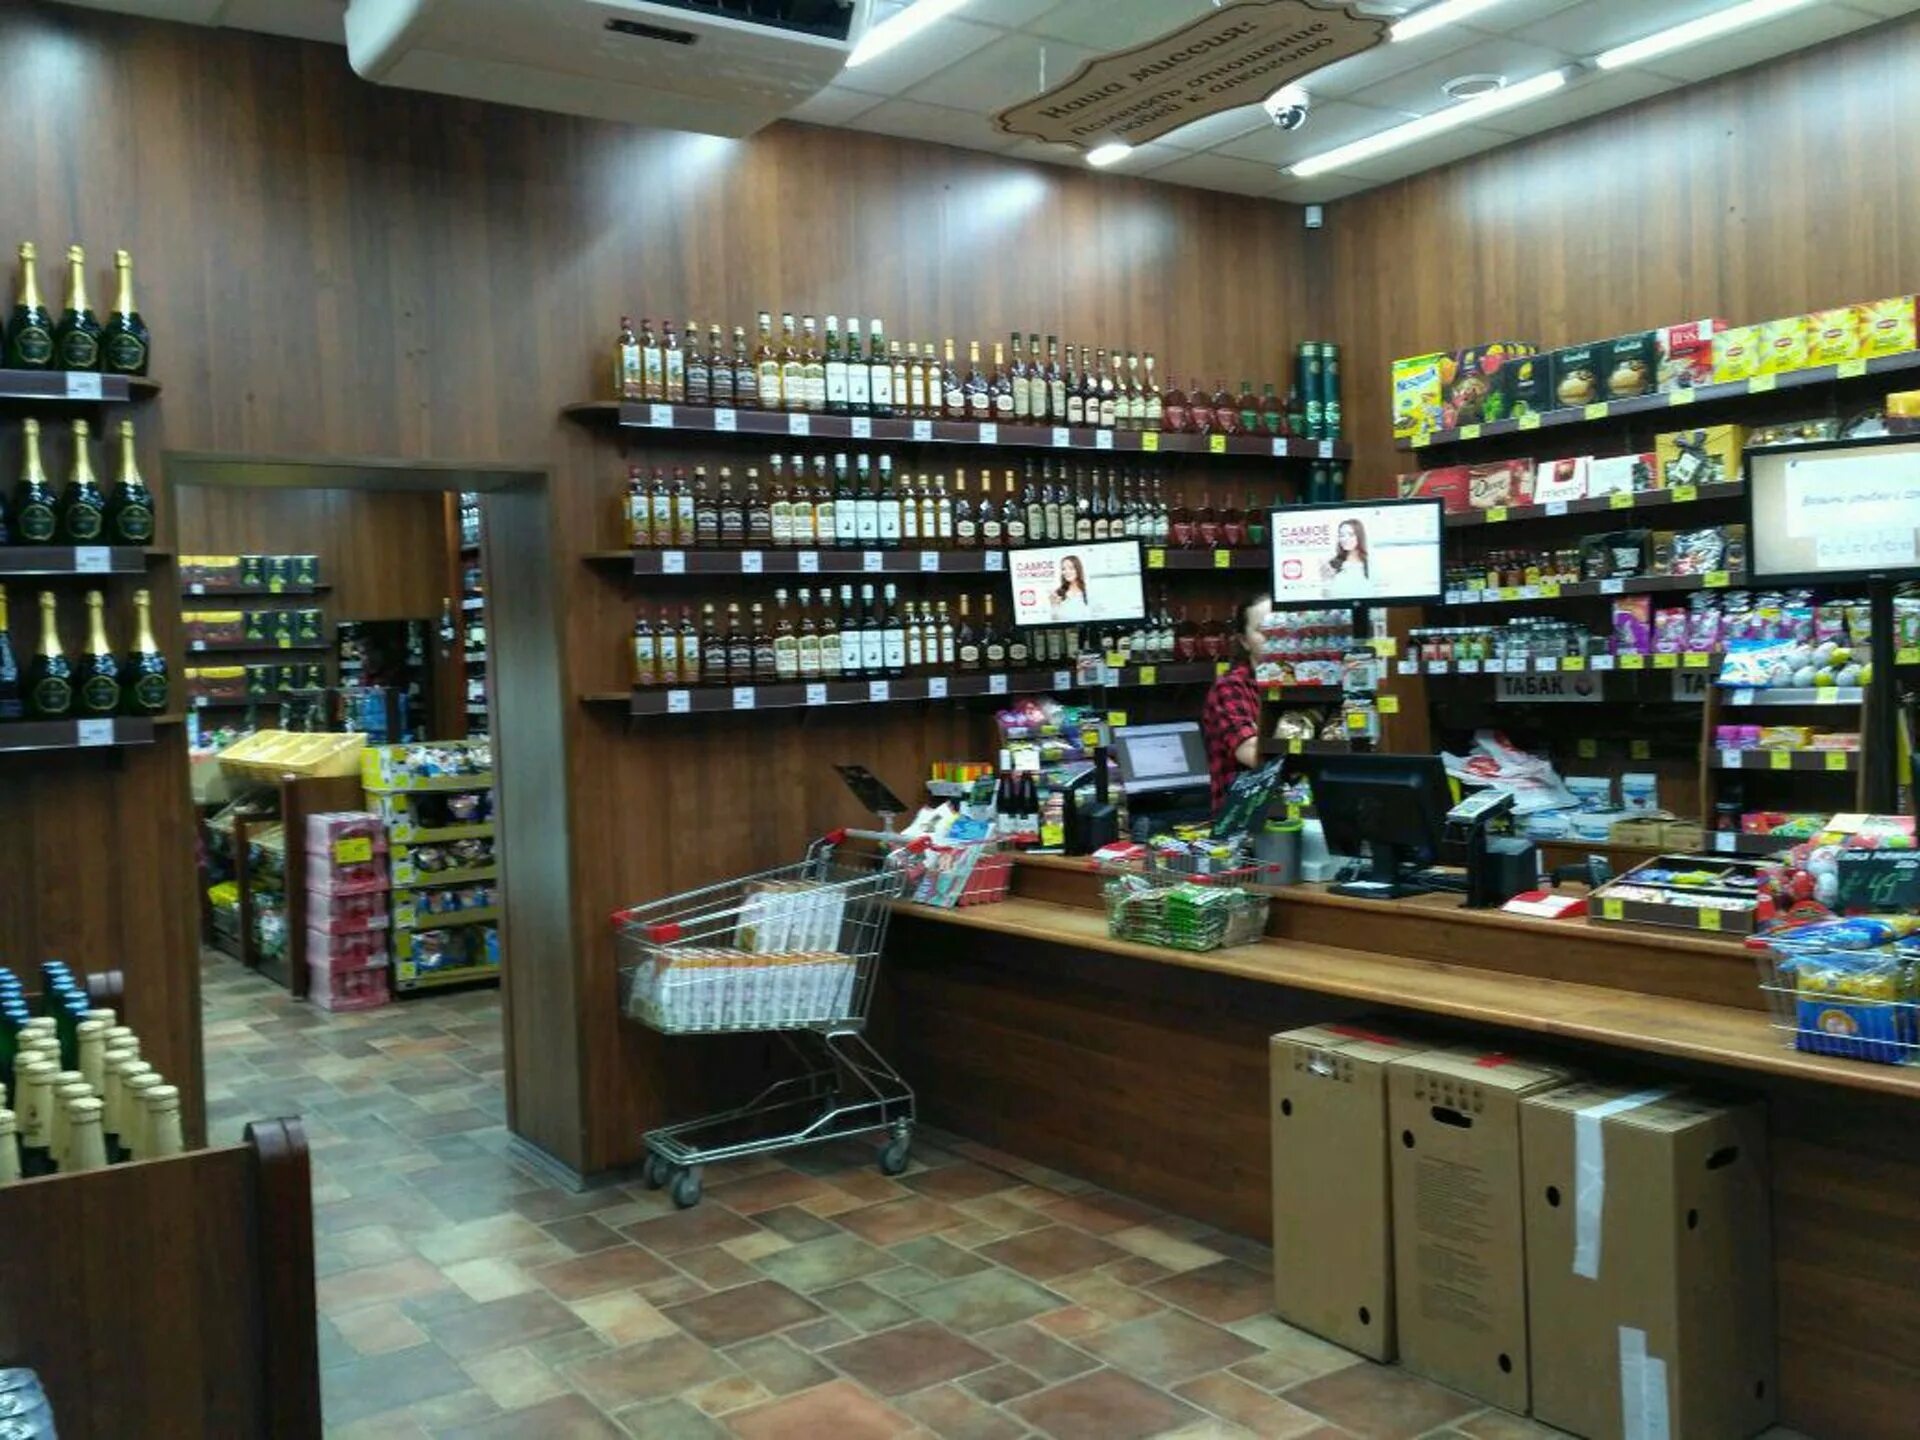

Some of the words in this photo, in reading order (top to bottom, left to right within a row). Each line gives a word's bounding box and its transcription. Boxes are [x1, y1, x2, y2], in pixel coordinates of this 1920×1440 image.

[1186, 22, 1329, 88] отношение
[1208, 37, 1335, 94] алкоголю
[1037, 81, 1126, 119] Наша
[1279, 525, 1330, 538] САМОЕ
[1015, 560, 1055, 571] САМОЕ
[1503, 675, 1565, 695] ТАБАК
